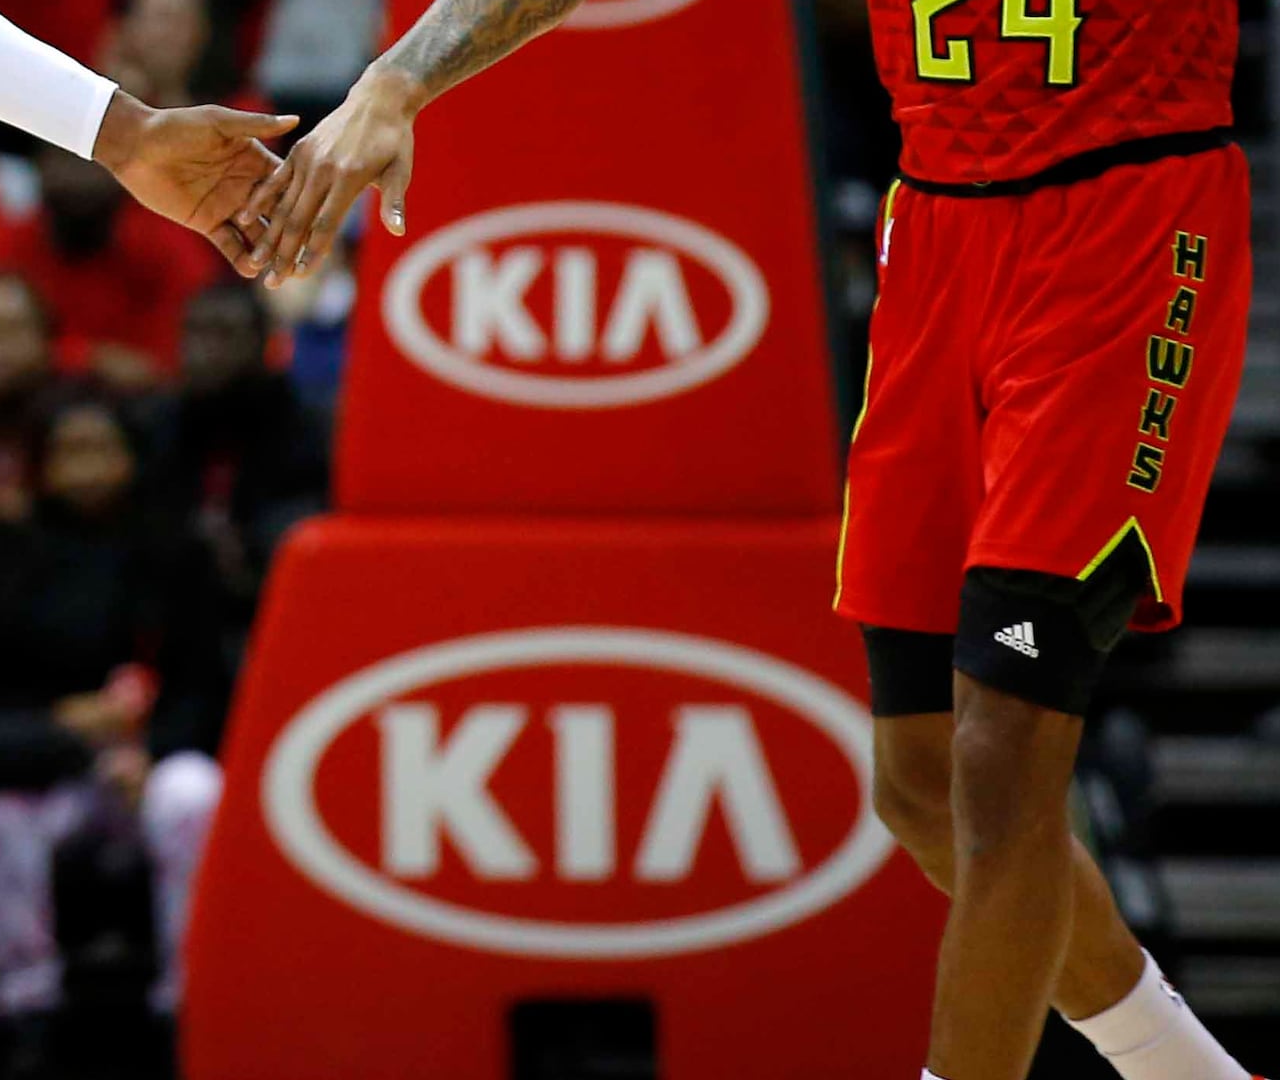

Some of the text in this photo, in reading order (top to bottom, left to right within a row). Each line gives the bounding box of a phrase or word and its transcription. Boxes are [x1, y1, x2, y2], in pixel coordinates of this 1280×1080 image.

[448, 245, 702, 361] KIA
[1126, 230, 1209, 494] HAWKS
[993, 631, 1039, 658] adidas
[377, 704, 805, 883] KIA
